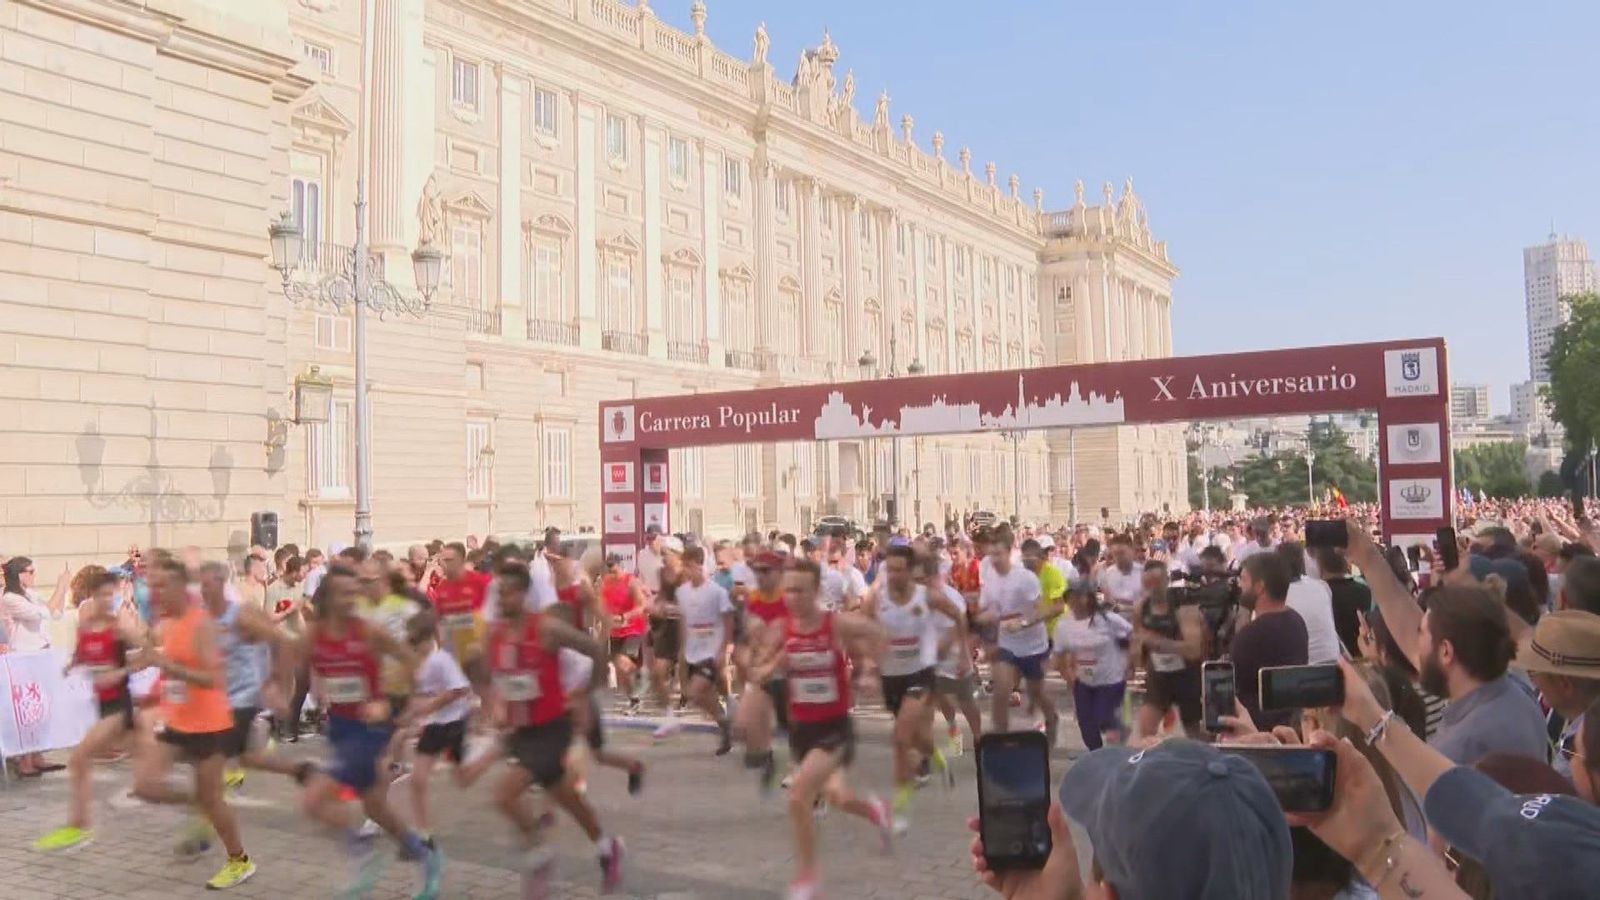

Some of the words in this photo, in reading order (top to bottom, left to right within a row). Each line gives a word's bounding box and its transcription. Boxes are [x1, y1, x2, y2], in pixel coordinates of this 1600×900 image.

[1151, 375, 1176, 401] X
[1187, 366, 1356, 399] Aniversario
[1394, 384, 1431, 393] MADRID
[640, 411, 711, 433] Carrera
[717, 402, 800, 432] Popular
